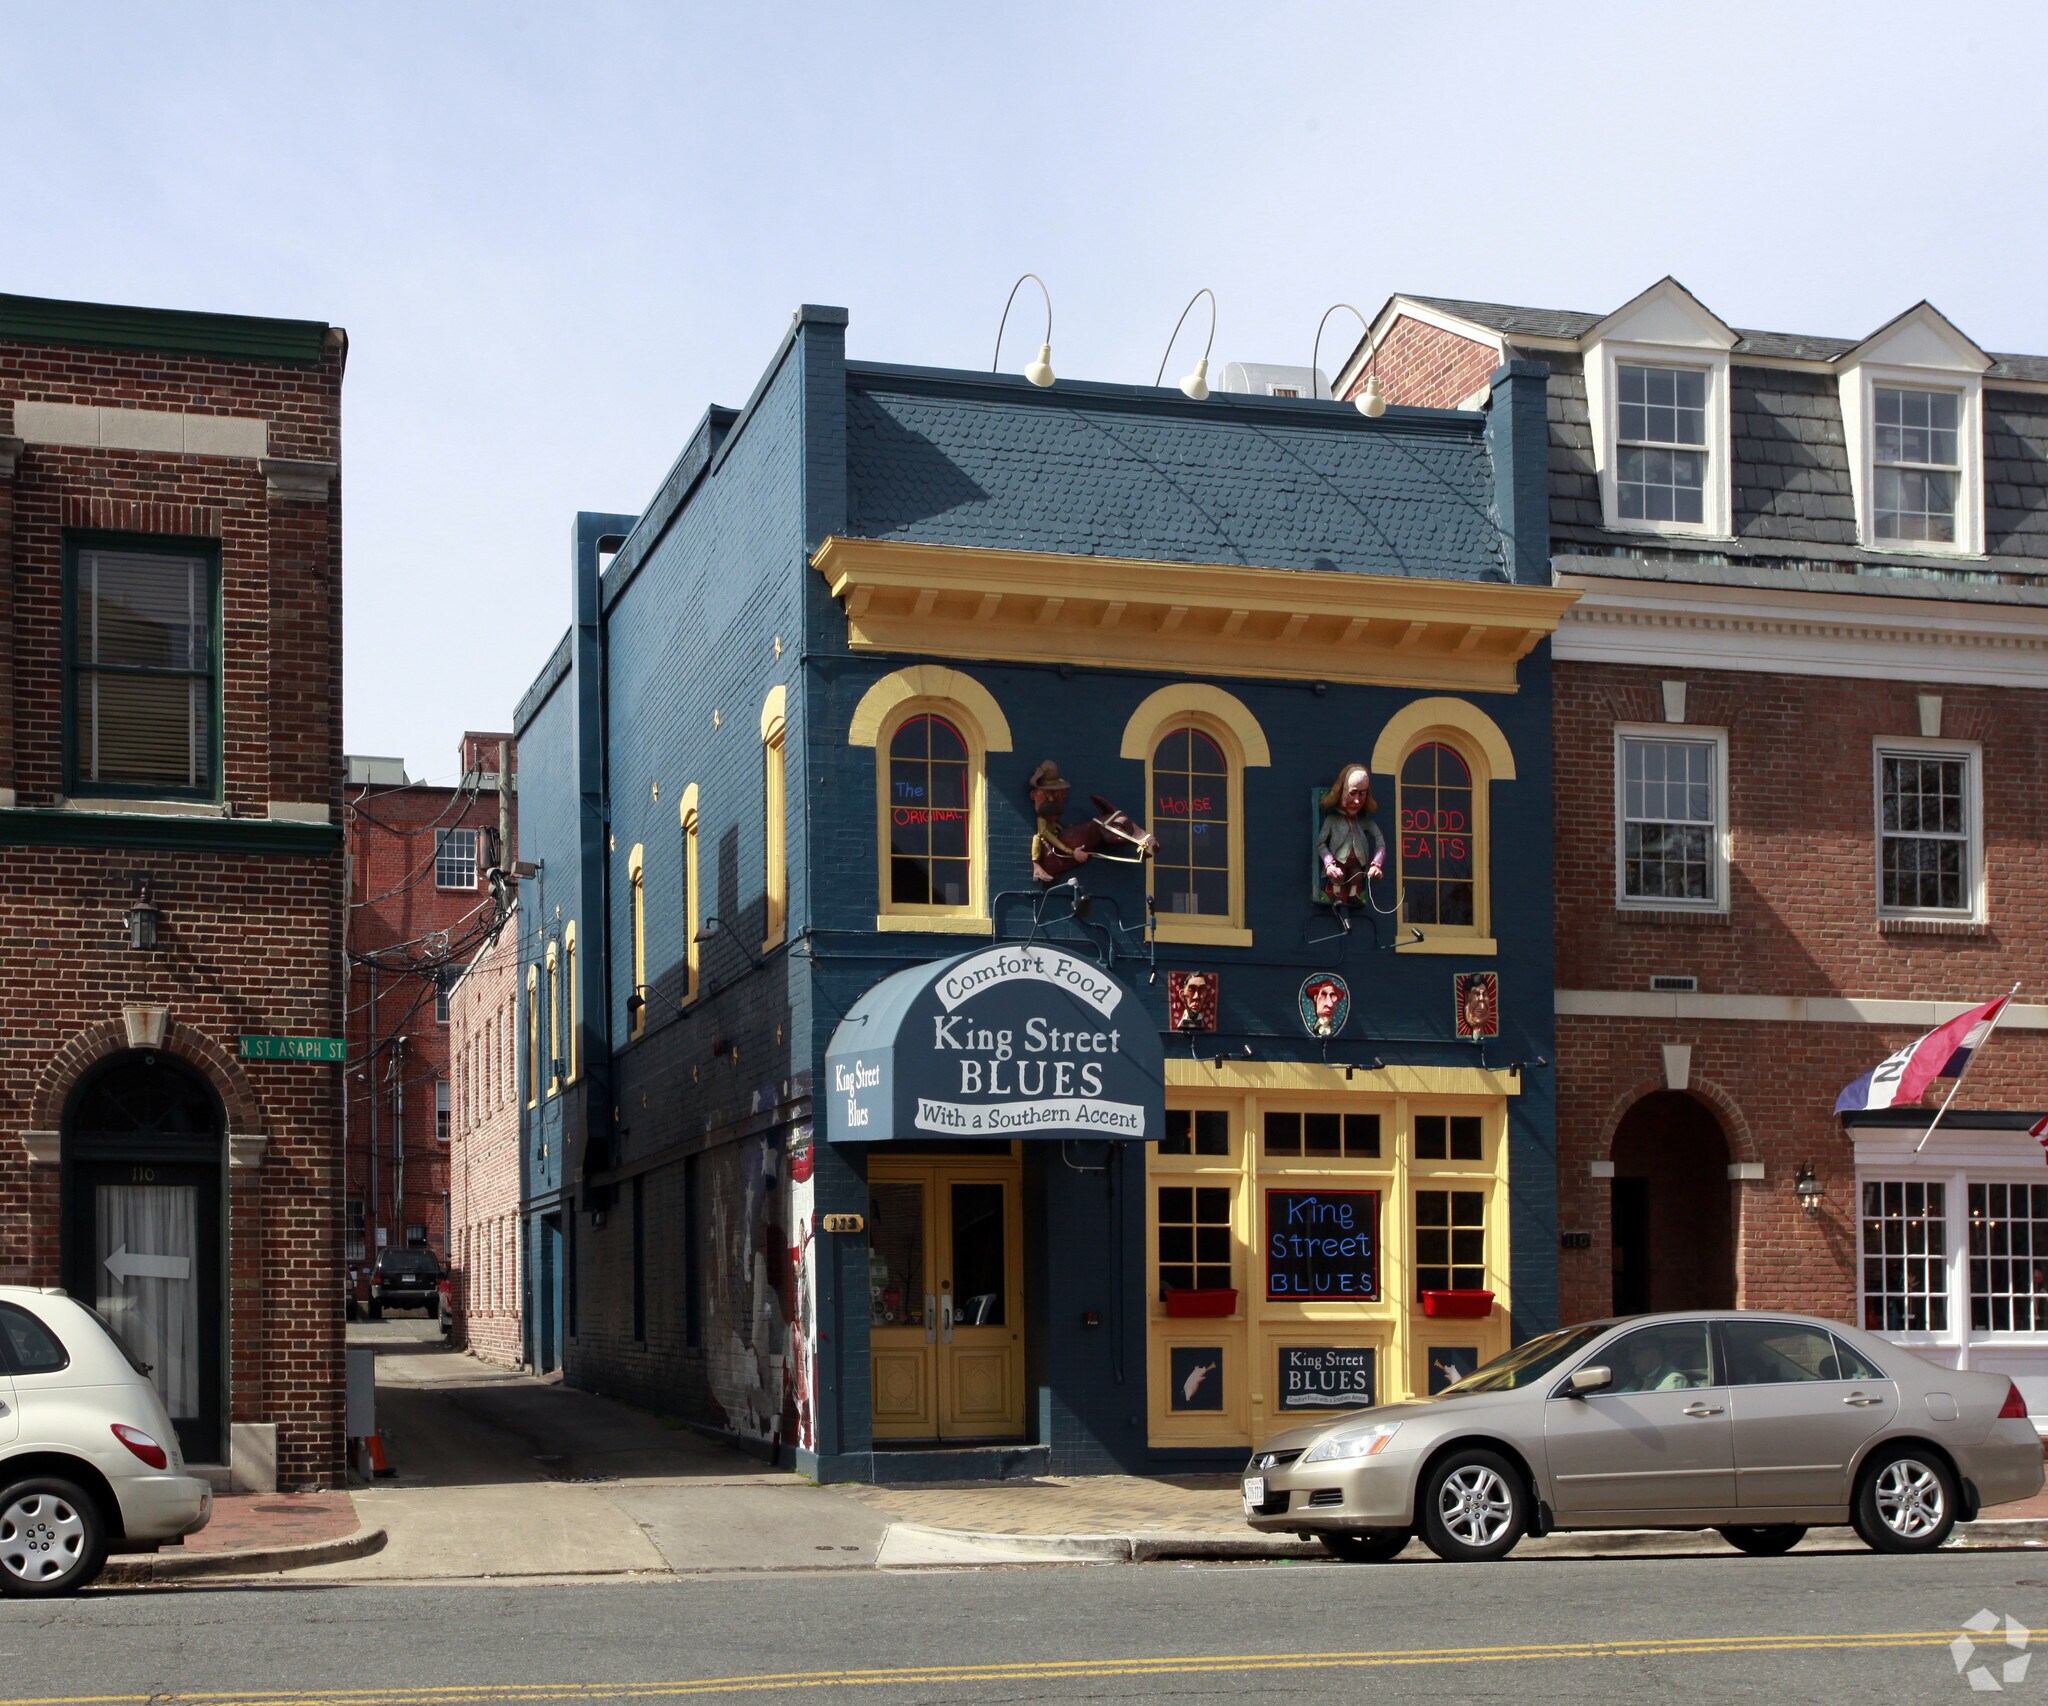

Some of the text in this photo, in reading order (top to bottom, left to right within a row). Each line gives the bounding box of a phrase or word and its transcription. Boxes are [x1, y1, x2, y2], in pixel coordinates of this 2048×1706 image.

[895, 781, 924, 798] The
[1401, 809, 1465, 831] GOOD
[1402, 837, 1466, 860] EATS
[946, 954, 1113, 1004] Comfort Food
[279, 1041, 321, 1058] ASAPH
[933, 1015, 1121, 1060] King Street
[835, 1060, 880, 1097] King Street
[959, 1060, 1103, 1098] BLUES
[847, 1099, 868, 1128] Blues
[922, 1103, 1138, 1129] With a Southern Accent
[132, 1166, 155, 1182] 110
[1288, 1197, 1354, 1229] King
[1271, 1232, 1371, 1258] Street
[1271, 1273, 1372, 1292] BLUES
[1290, 1351, 1364, 1370] King Street
[1289, 1370, 1366, 1390] BLUES
